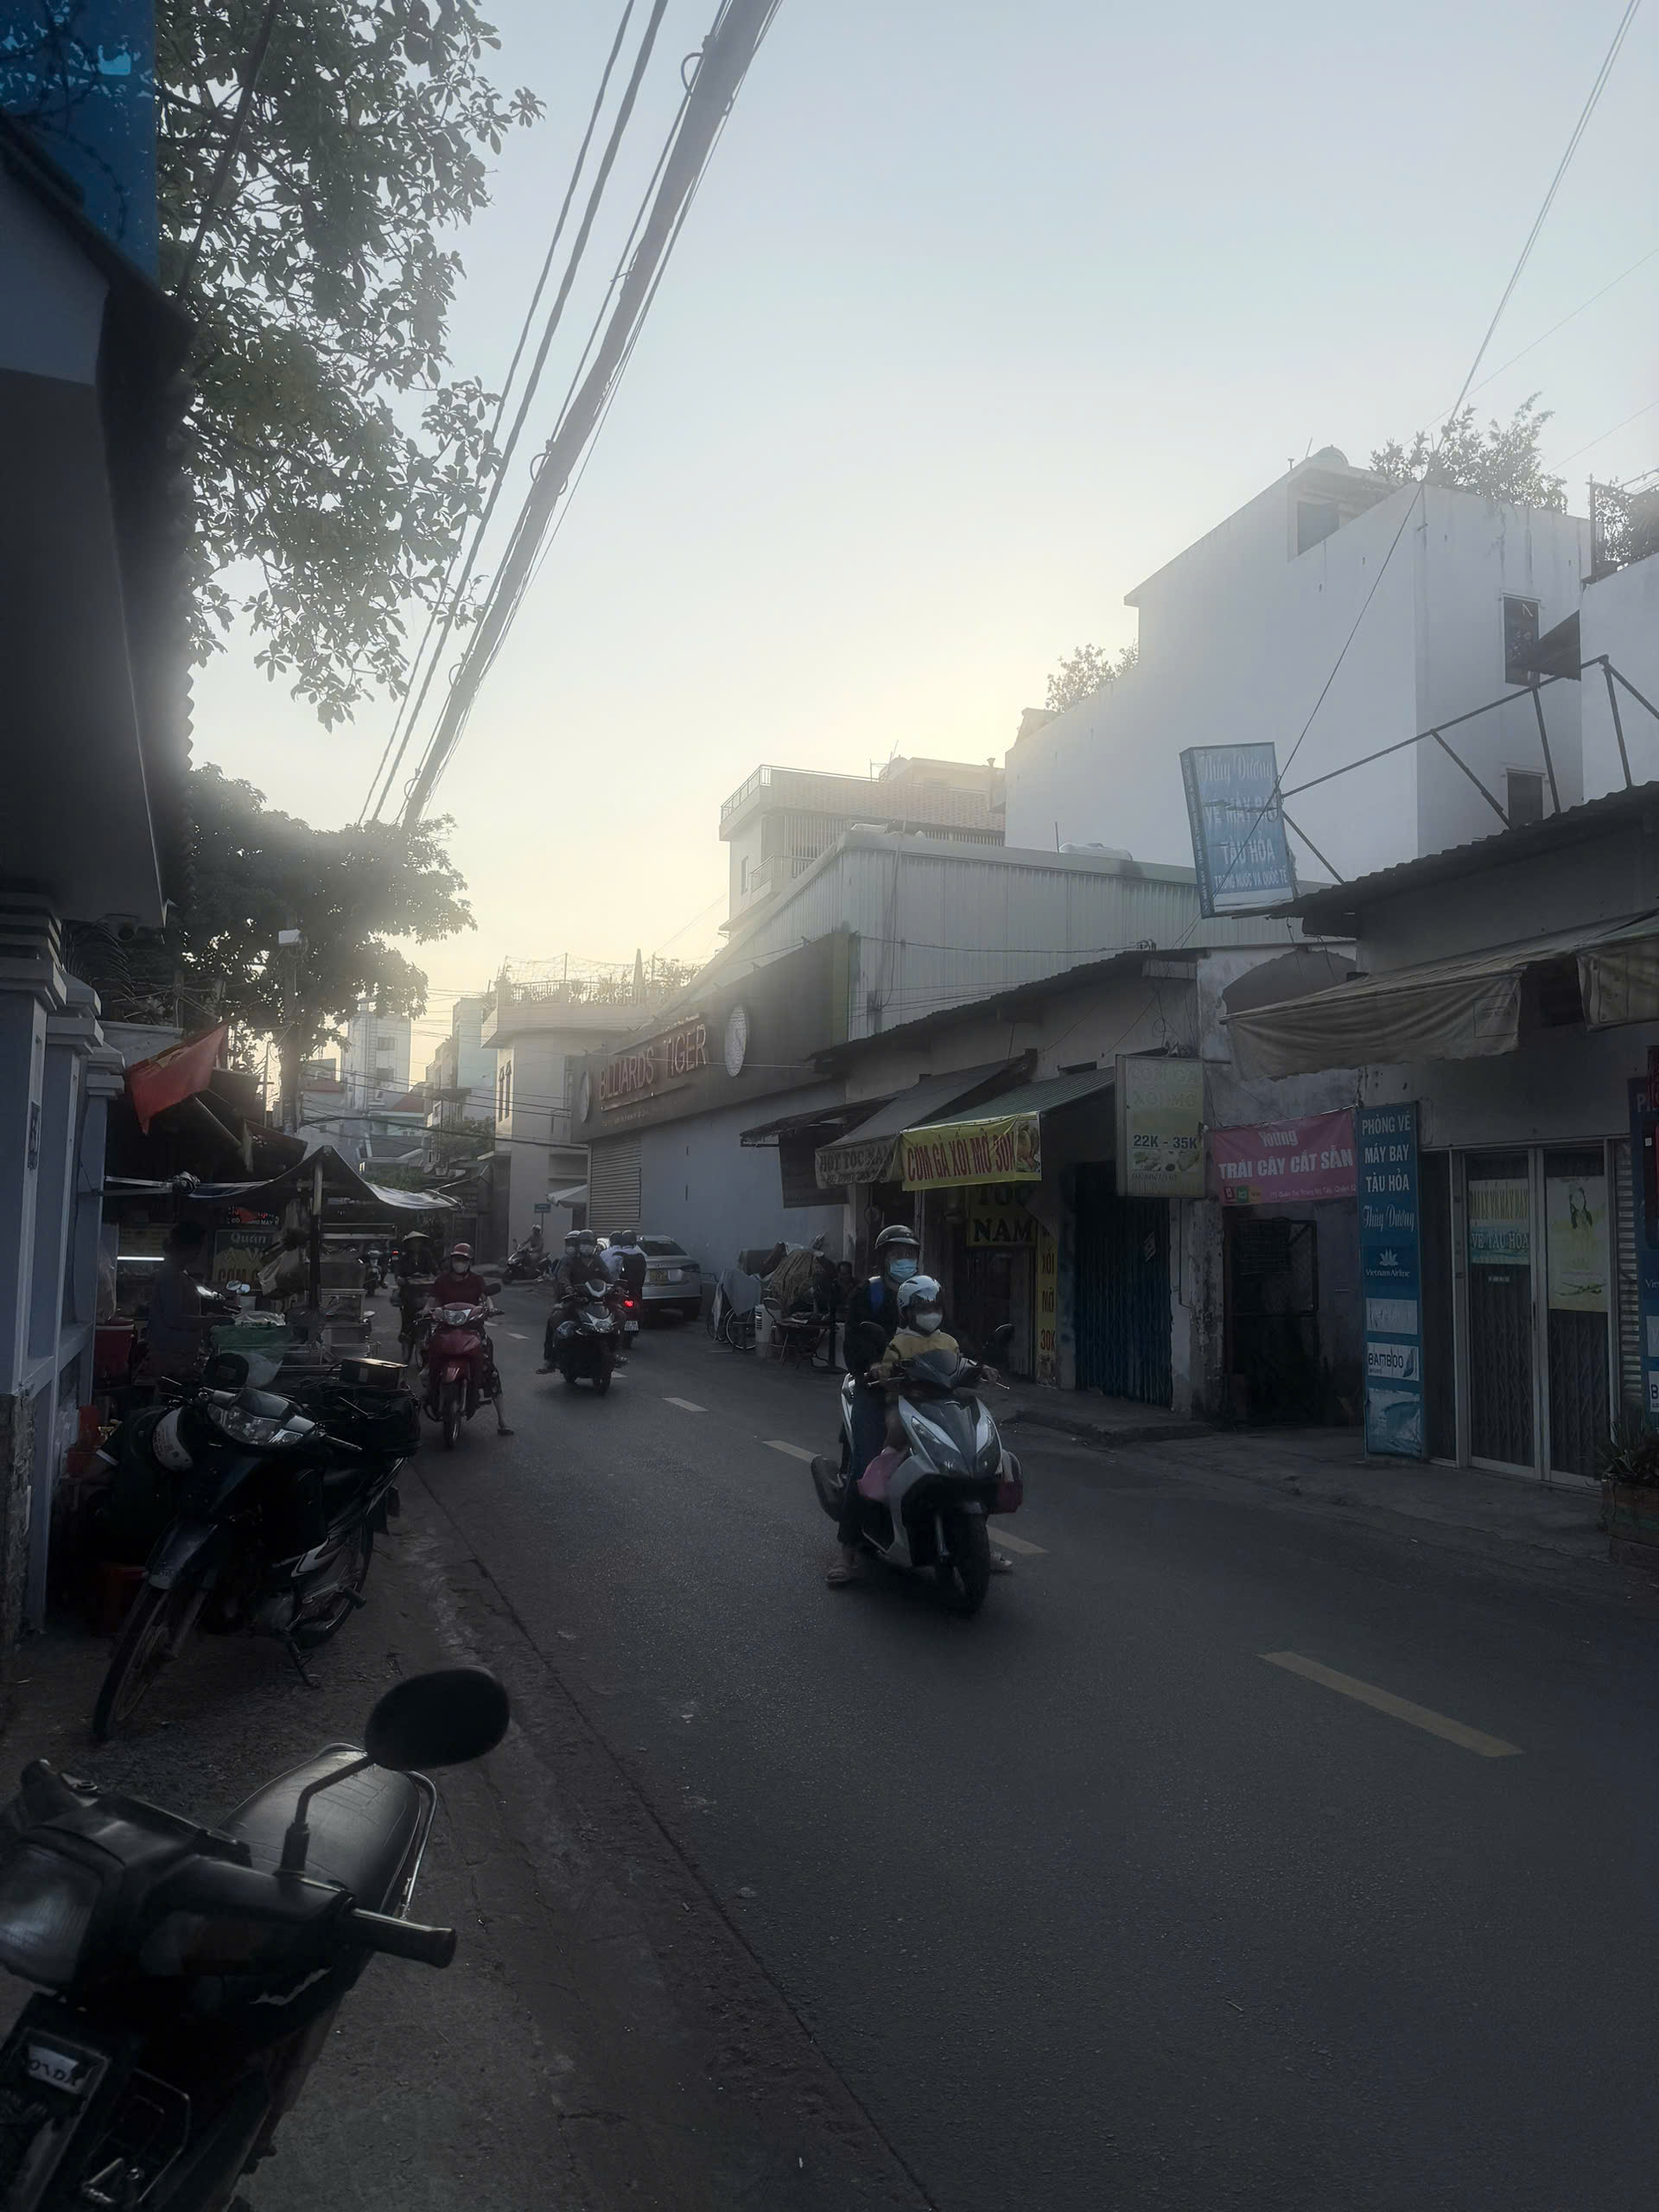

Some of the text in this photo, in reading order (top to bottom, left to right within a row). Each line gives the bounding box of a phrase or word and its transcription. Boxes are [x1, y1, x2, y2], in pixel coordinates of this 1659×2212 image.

[1220, 831, 1275, 865] TÀU HỎA
[664, 1023, 707, 1077] TIGER
[1362, 1109, 1411, 1135] PHÒNG VÉ
[1133, 1135, 1159, 1147] 22K
[1173, 1136, 1198, 1149] 35K
[1259, 1128, 1299, 1147] Young
[1364, 1141, 1410, 1164] MÁY BAY
[1218, 1156, 1254, 1179] TRÁI
[1257, 1154, 1286, 1177] CÂY
[1365, 1167, 1410, 1193] TÀU HỎA
[973, 1218, 1033, 1243] NAM
[1386, 1203, 1414, 1233] Dương
[1486, 1227, 1507, 1250] TÀU
[1368, 1352, 1404, 1370] BAMBOO
